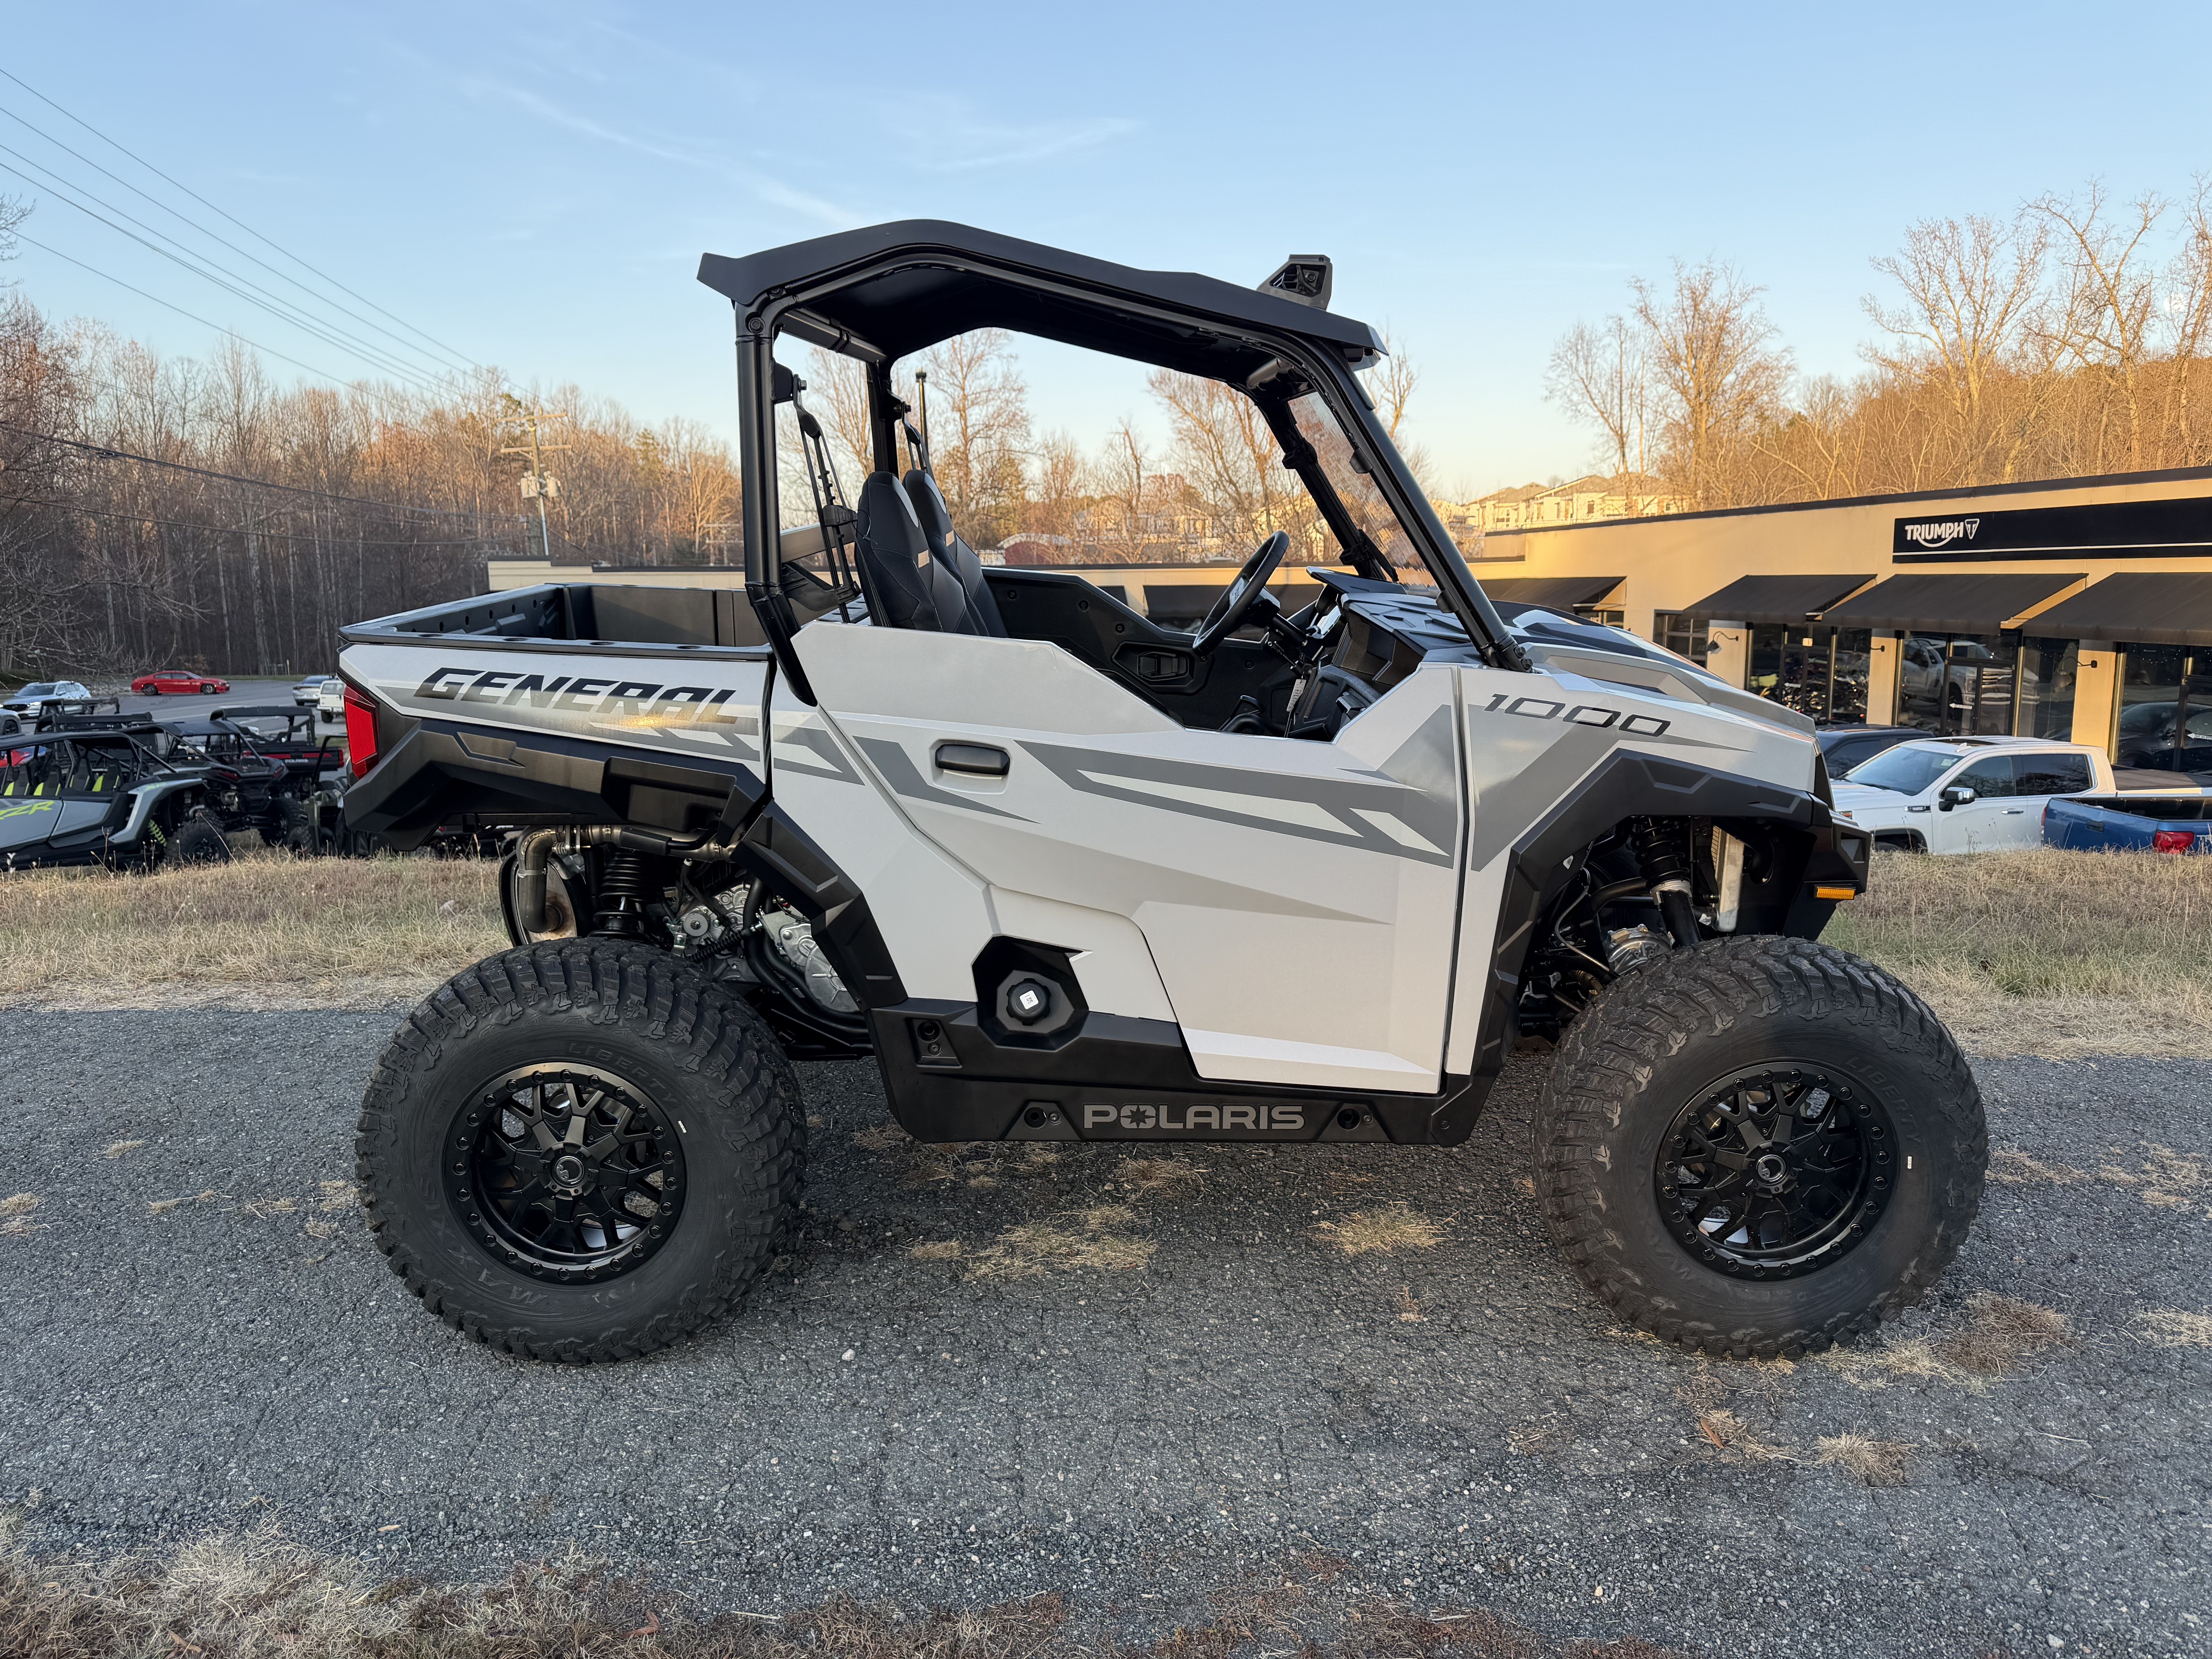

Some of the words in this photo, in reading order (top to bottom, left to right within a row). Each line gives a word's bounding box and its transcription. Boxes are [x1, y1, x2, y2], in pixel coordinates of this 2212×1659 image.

[1905, 522, 1964, 548] TRIUMPH
[413, 667, 737, 724] GENERAL
[1484, 693, 1671, 737] 1000
[0, 800, 54, 820] ZR
[569, 1044, 681, 1108] LIBERTY
[1846, 1057, 1922, 1144] LIBERTY
[1084, 1104, 1305, 1130] POLARIS
[421, 1176, 548, 1308] MAXXIS
